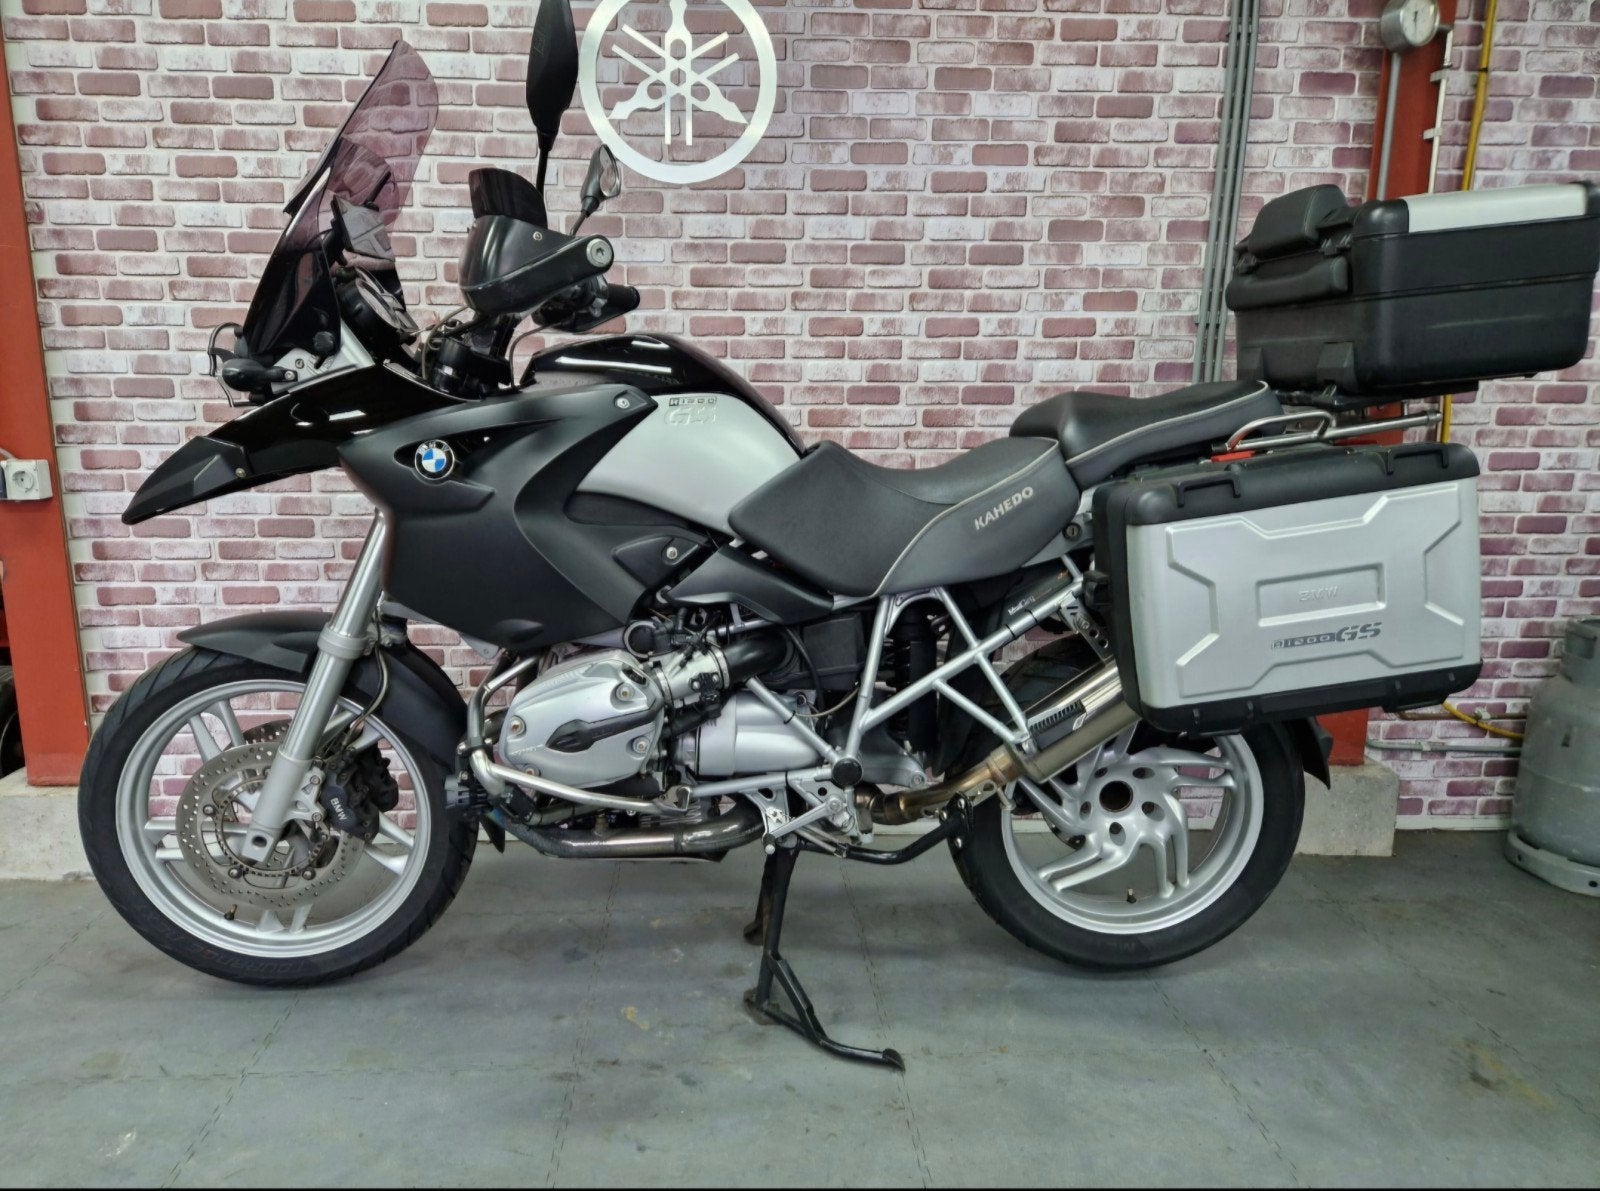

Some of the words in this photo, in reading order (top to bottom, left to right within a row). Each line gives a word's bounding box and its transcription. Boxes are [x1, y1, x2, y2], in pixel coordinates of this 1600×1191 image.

[974, 486, 1034, 530] KAHEDO
[1298, 586, 1338, 601] BMW
[330, 797, 347, 820] BMW
